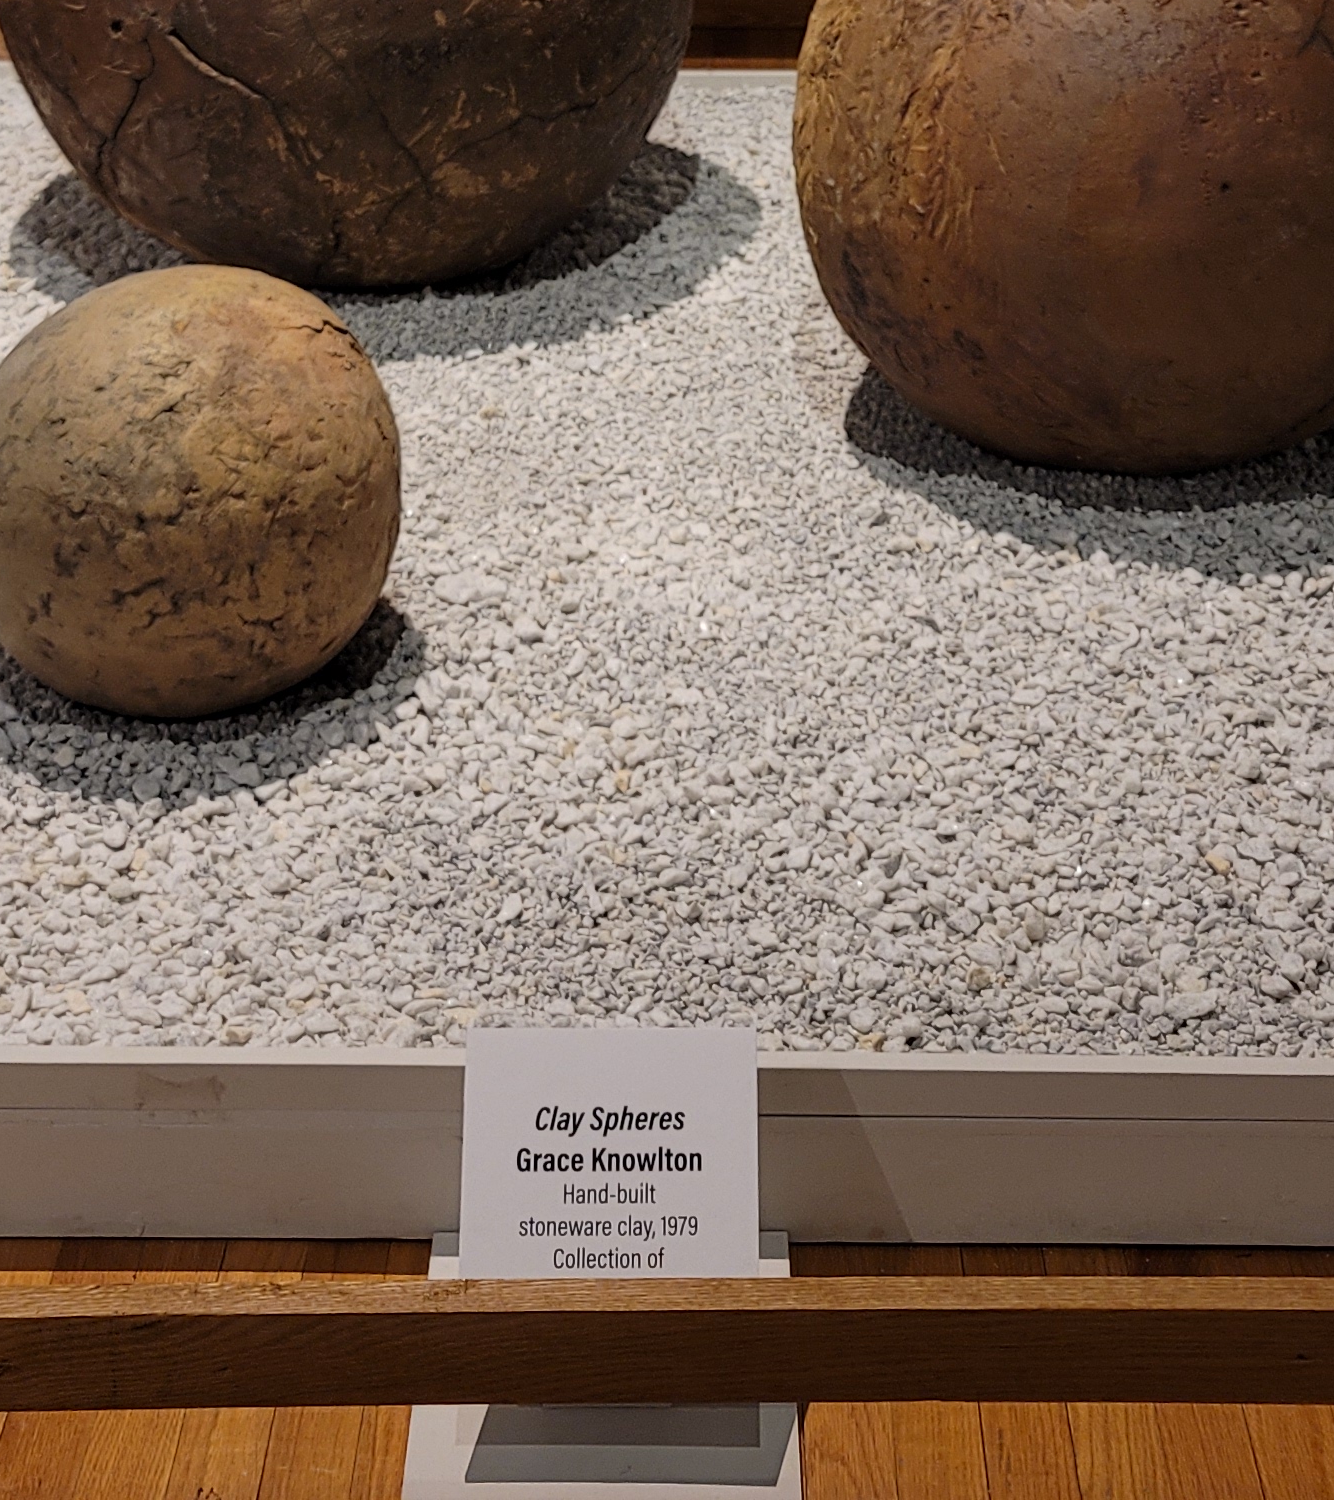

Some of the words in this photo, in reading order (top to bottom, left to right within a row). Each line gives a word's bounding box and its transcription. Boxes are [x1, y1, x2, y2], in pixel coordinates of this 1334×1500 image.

[535, 1105, 585, 1137] Clay
[589, 1105, 685, 1137] Spheres
[517, 1148, 584, 1172] Grace
[592, 1146, 702, 1172] Knowlton
[563, 1181, 657, 1205] Hand-built
[519, 1216, 612, 1237] stoneware
[618, 1214, 655, 1242] clay,
[660, 1215, 698, 1237] 1979
[553, 1246, 641, 1269] Collection
[648, 1246, 665, 1269] of
